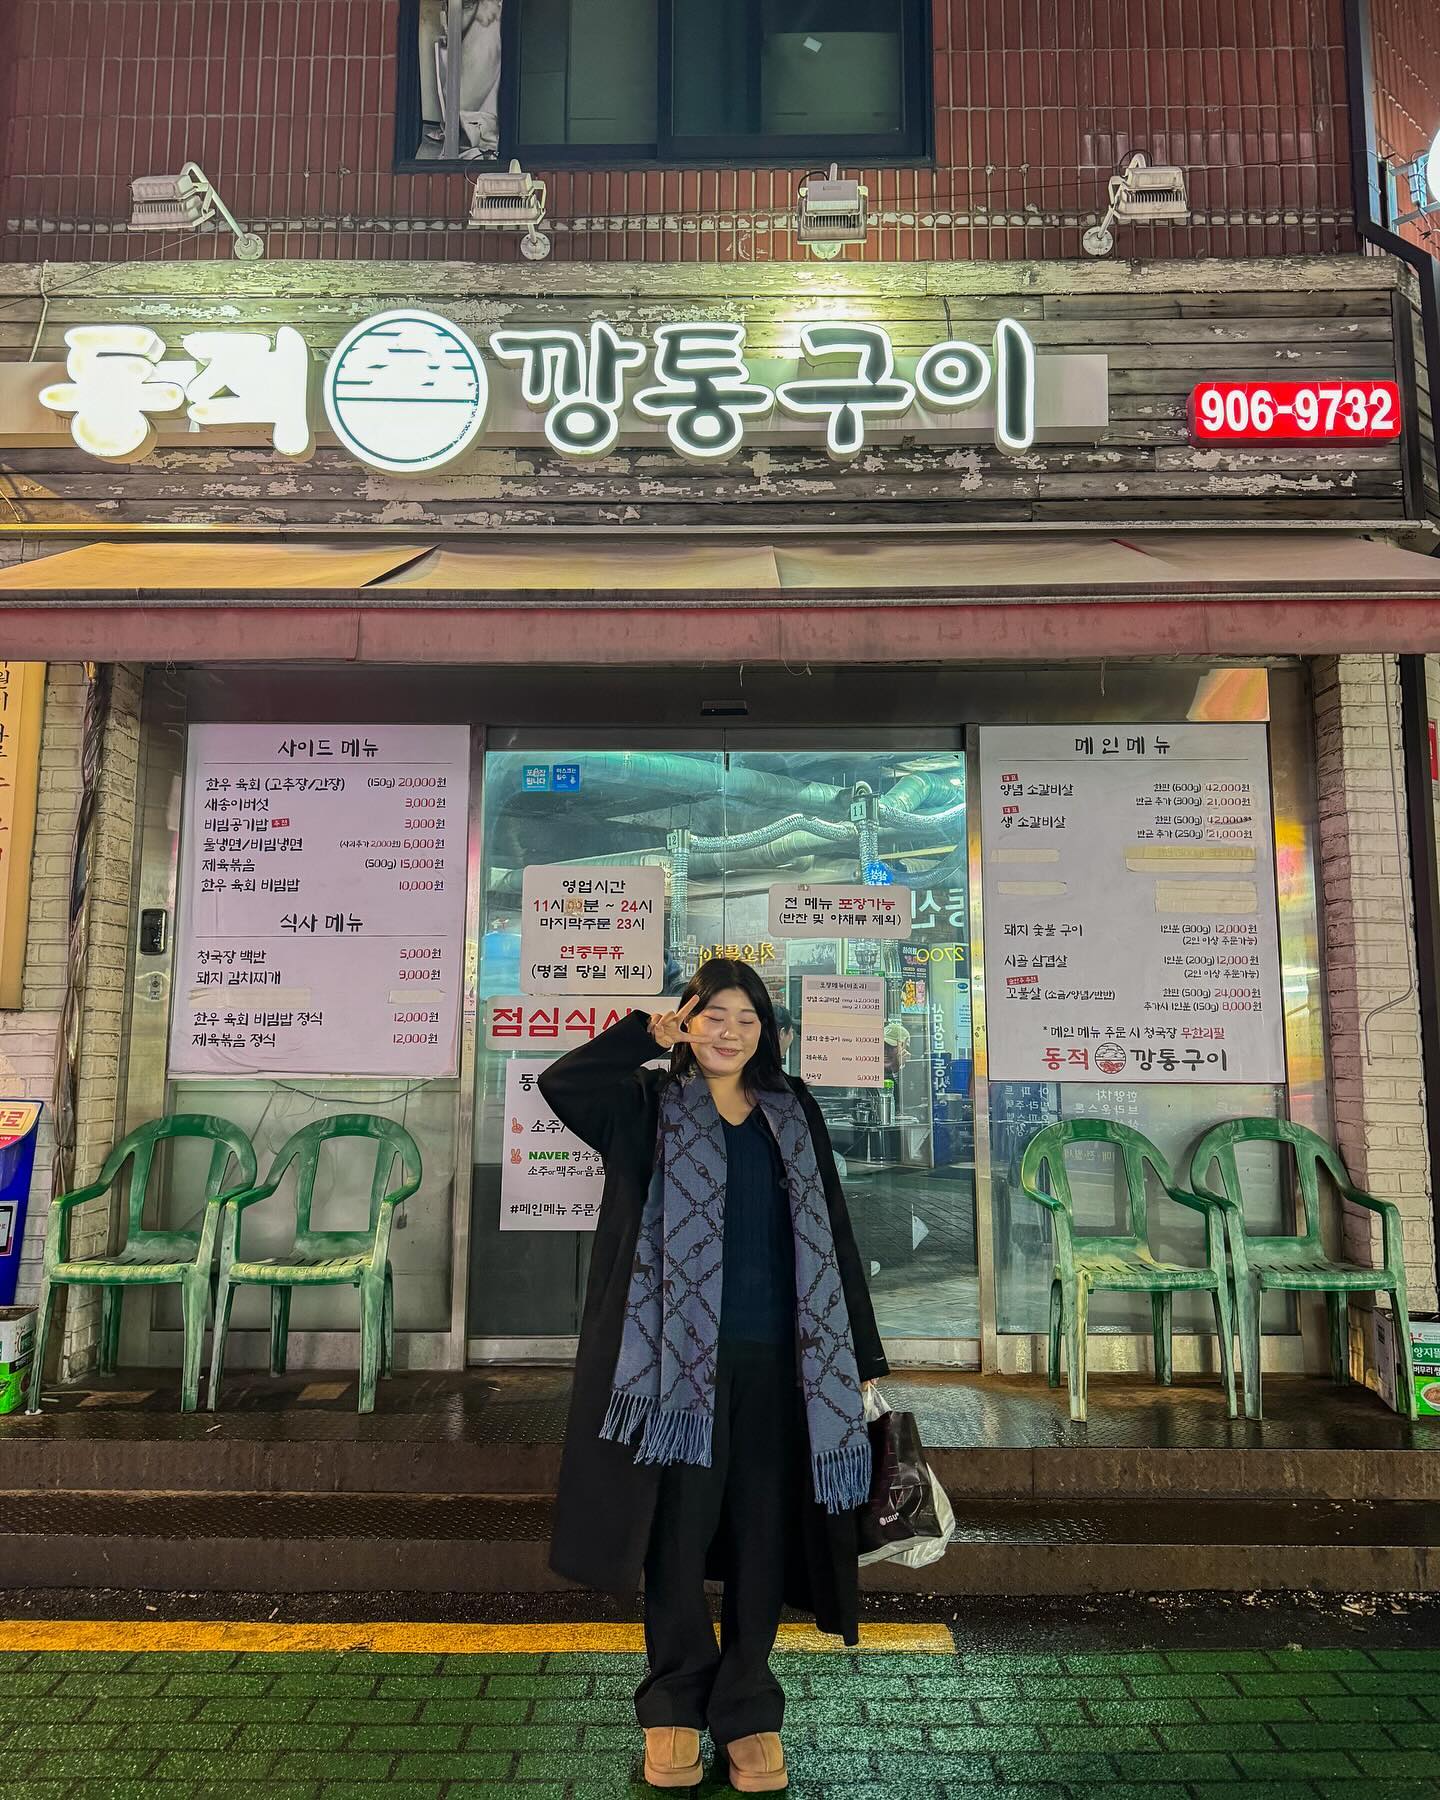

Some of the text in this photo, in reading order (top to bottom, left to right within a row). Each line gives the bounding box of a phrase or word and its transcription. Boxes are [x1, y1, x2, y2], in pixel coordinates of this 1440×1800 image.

[491, 319, 1036, 456] 깡통구이
[1199, 387, 1395, 435] 906-9732
[277, 738, 380, 758] 사이드 메뉴
[206, 777, 446, 792] 한우 육회 (고추장/간장) (150g) 20,000원
[1000, 784, 1023, 796] 양념
[1026, 784, 1074, 796] 소갈비살
[1172, 784, 1202, 793] (600g)
[1206, 784, 1250, 792] 42,000원
[204, 798, 446, 812] 새송이버섯 3,000원
[1154, 796, 1172, 806] 추가
[1173, 796, 1202, 807] (300g)
[1206, 797, 1252, 806] 21,000원
[204, 818, 269, 832] 비빔공기밥
[404, 818, 445, 829] 3,000원
[1000, 816, 1013, 829] 생
[1018, 816, 1066, 829] 소갈비살
[1174, 815, 1203, 826] (500g)
[1156, 830, 1172, 839] 추가
[1174, 829, 1204, 840] (250g)
[1208, 830, 1253, 840] 21,000원
[203, 838, 303, 852] 물냉면/비빔냉면
[370, 840, 400, 848] 2,000원)
[403, 838, 445, 850] 6,000원
[202, 858, 444, 872] 제육볶음 (500g) 15,000원
[201, 878, 444, 892] 한우 육회 비빔밥 10,000원
[562, 880, 626, 894] 영업시간
[620, 898, 652, 914] 24시
[784, 897, 896, 911] 전 메뉴 포장가능
[280, 912, 364, 933] 식사 메뉴
[540, 918, 645, 930] 마지막주문 23시
[812, 913, 824, 925] 및
[830, 913, 868, 926] 야채류
[872, 913, 902, 926] 제외)
[1004, 924, 1258, 937] 돼지 숯불 구이 1인분 (300g) 12,000원
[1182, 936, 1258, 946] (2인 이상 주문가능)
[197, 948, 442, 964] 청국장 백반 5,000원
[560, 946, 624, 960] 연중무휴
[1004, 954, 1260, 968] 시골 삼겹살 1인분 (200g) 12,000원
[196, 971, 224, 985] 돼지
[228, 971, 282, 985] 김치찌개
[532, 964, 653, 980] (명절 당일 제외)
[1184, 969, 1260, 979] (2인 이상 주문가능)
[1044, 990, 1116, 1000] (소금/양념/반반)
[1182, 988, 1212, 998] (500g)
[1214, 988, 1261, 998] 24,000원
[1144, 1002, 1262, 1012] 추가시 1인분 (150g) 8,000원
[193, 1011, 440, 1026] 한우 육회 비빔밥 정식 12,000원
[191, 1032, 438, 1048] 제육볶음 정식 12,000원
[1050, 1026, 1226, 1040] 메인 메뉴 주문 시 청국장 무한리필
[1042, 1047, 1228, 1072] 동적 깡통구이
[528, 1152, 570, 1160] NAVER
[510, 1203, 600, 1216] #메인메뉴 주문
